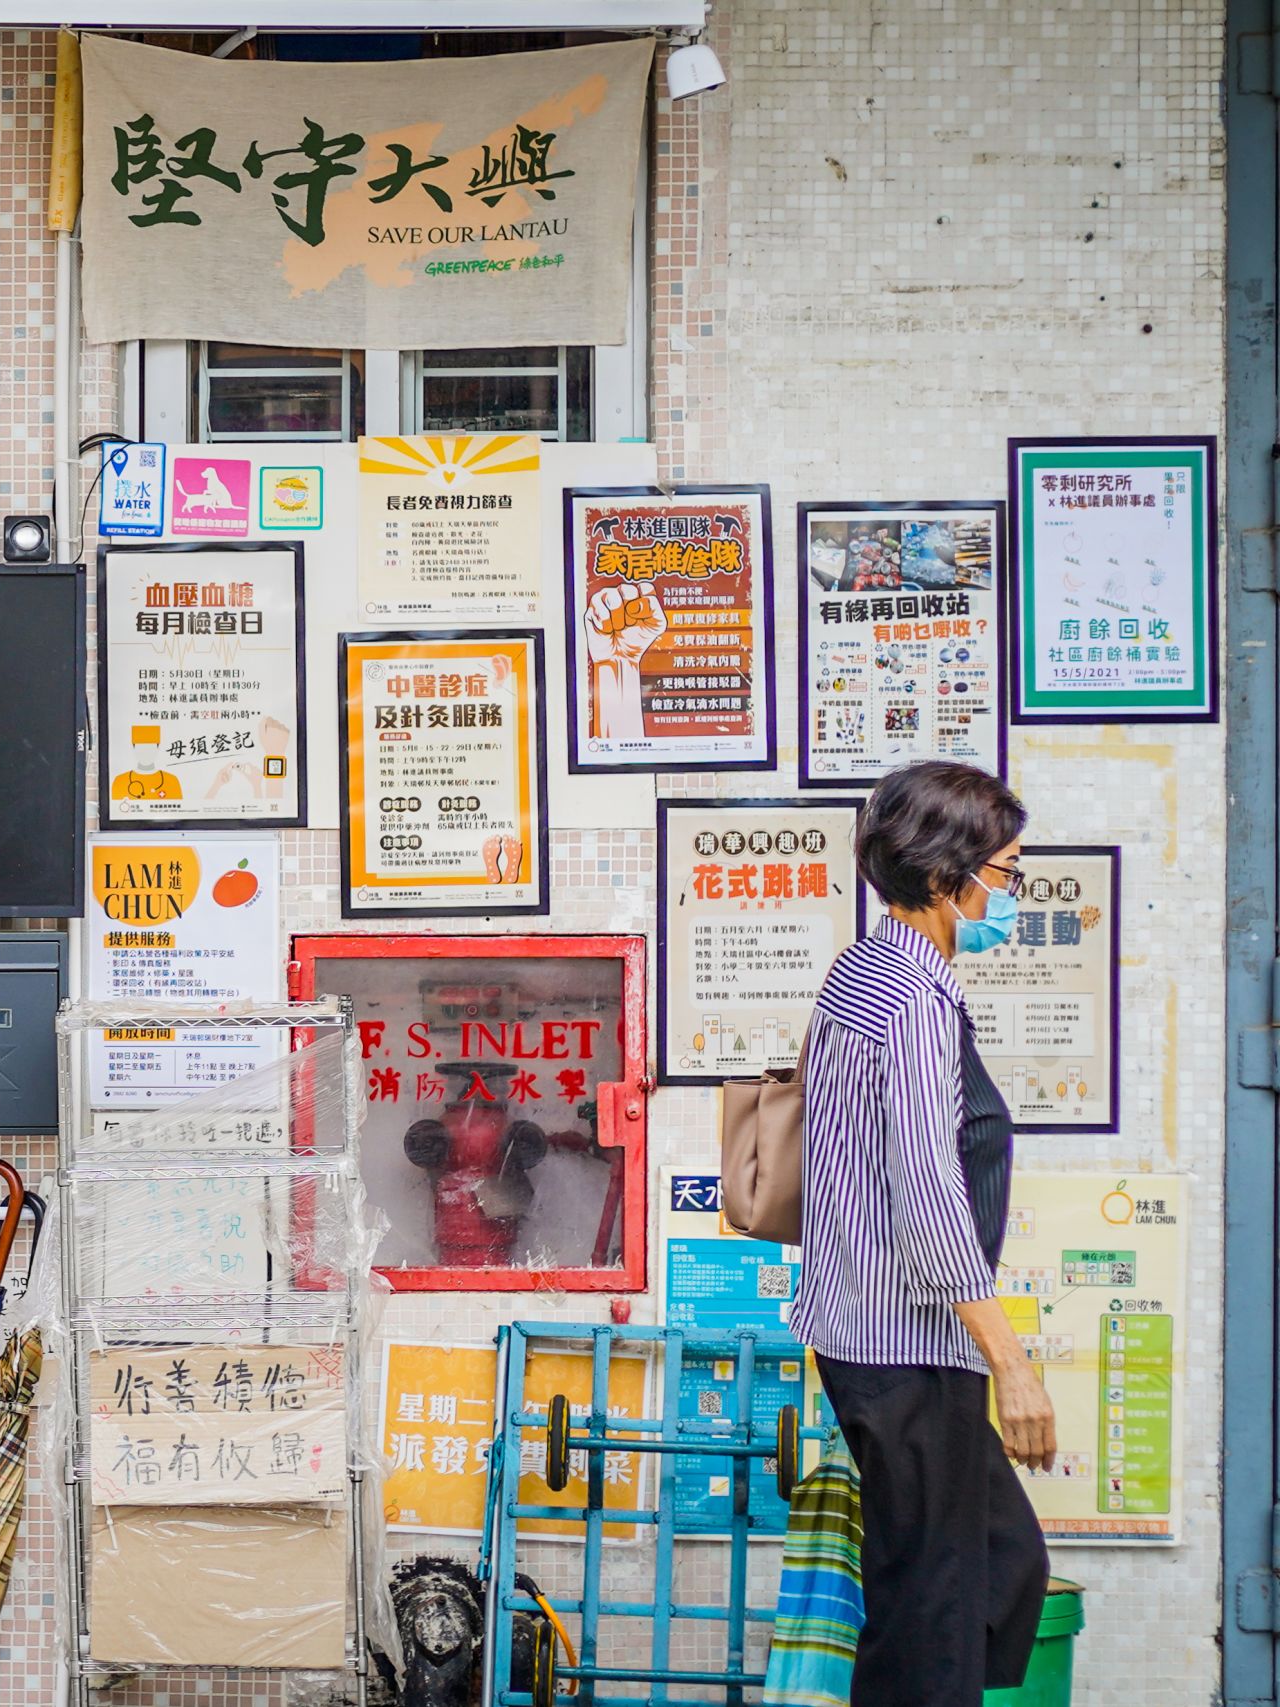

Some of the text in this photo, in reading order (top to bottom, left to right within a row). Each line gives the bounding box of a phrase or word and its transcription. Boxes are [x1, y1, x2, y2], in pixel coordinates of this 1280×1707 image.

[111, 113, 576, 248] 堅守大嶼
[367, 217, 569, 245] SAVE OUR LANTAU
[424, 258, 512, 277] GREENPEACE
[1041, 474, 1132, 493] 零剩研究所
[113, 499, 151, 509] WATER
[387, 495, 513, 511] 長者免費視力篩查
[1059, 494, 1156, 508] 林進議員辦事處
[624, 517, 710, 540] 林進團隊
[596, 540, 742, 580] 家居維修隊
[145, 582, 254, 608] 血壓血糖
[820, 592, 970, 624] 有緣再回收站
[135, 611, 263, 635] 每月檢查日
[1059, 618, 1170, 640] 廚餘回收
[1048, 646, 1180, 662] 社區廚餘桶實驗
[387, 673, 488, 698] 中醫診症
[1053, 668, 1119, 679] 15/5/2021
[375, 703, 503, 729] 及針灸服務
[697, 831, 824, 855] 瑞華興趣班
[104, 860, 183, 891] LAM 林進
[692, 863, 829, 900] 花式跳繩
[104, 893, 184, 920] CHUN
[108, 931, 171, 947] 提供服務
[1002, 910, 1082, 947] 運動
[408, 1022, 442, 1059] S.
[460, 1021, 601, 1060] INLET
[368, 1066, 588, 1104] 消防入水掣
[1135, 1199, 1166, 1215] 林進
[1135, 1215, 1177, 1225] LAM CHUN
